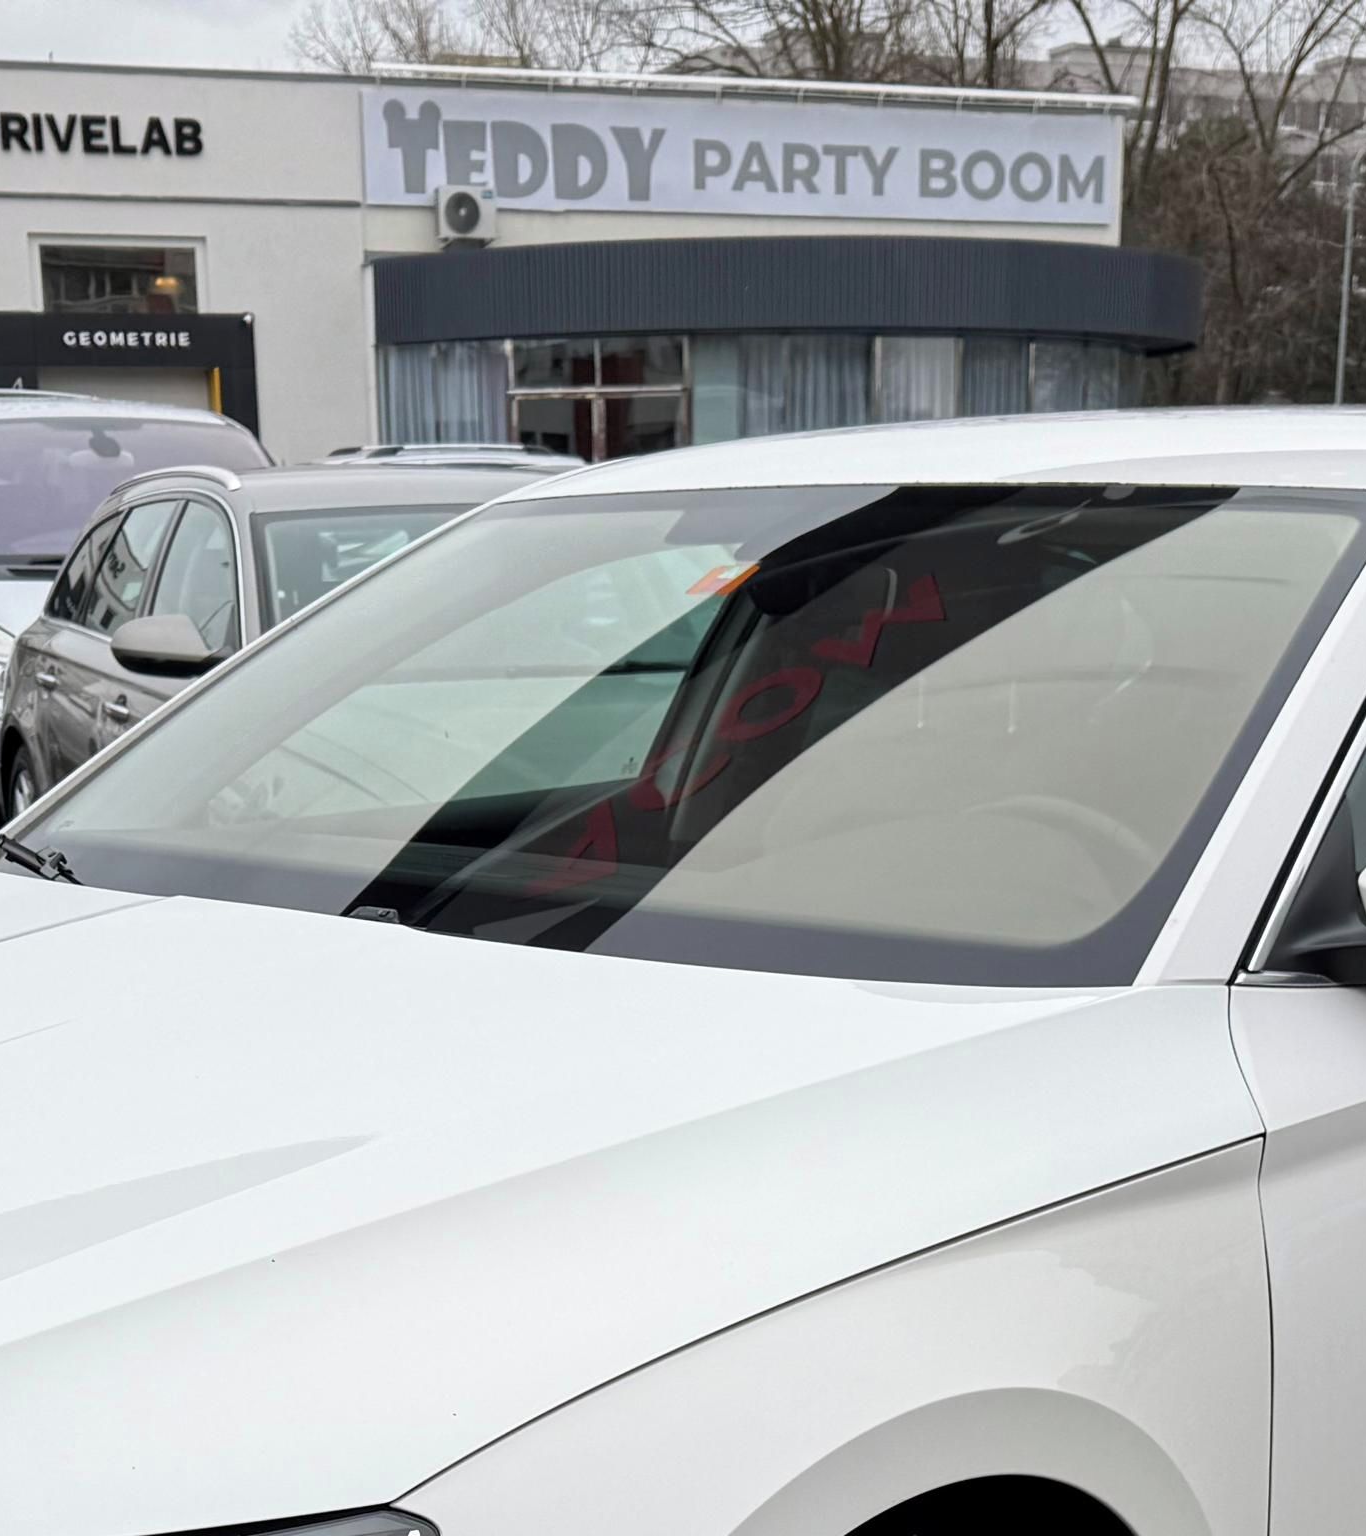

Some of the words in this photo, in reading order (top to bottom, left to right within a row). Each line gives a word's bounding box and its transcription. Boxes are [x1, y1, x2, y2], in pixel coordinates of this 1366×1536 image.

[382, 98, 666, 201] TEDDY
[693, 139, 898, 197] PARTY
[919, 149, 1105, 204] BOOM
[63, 331, 191, 347] GEOMETRIE
